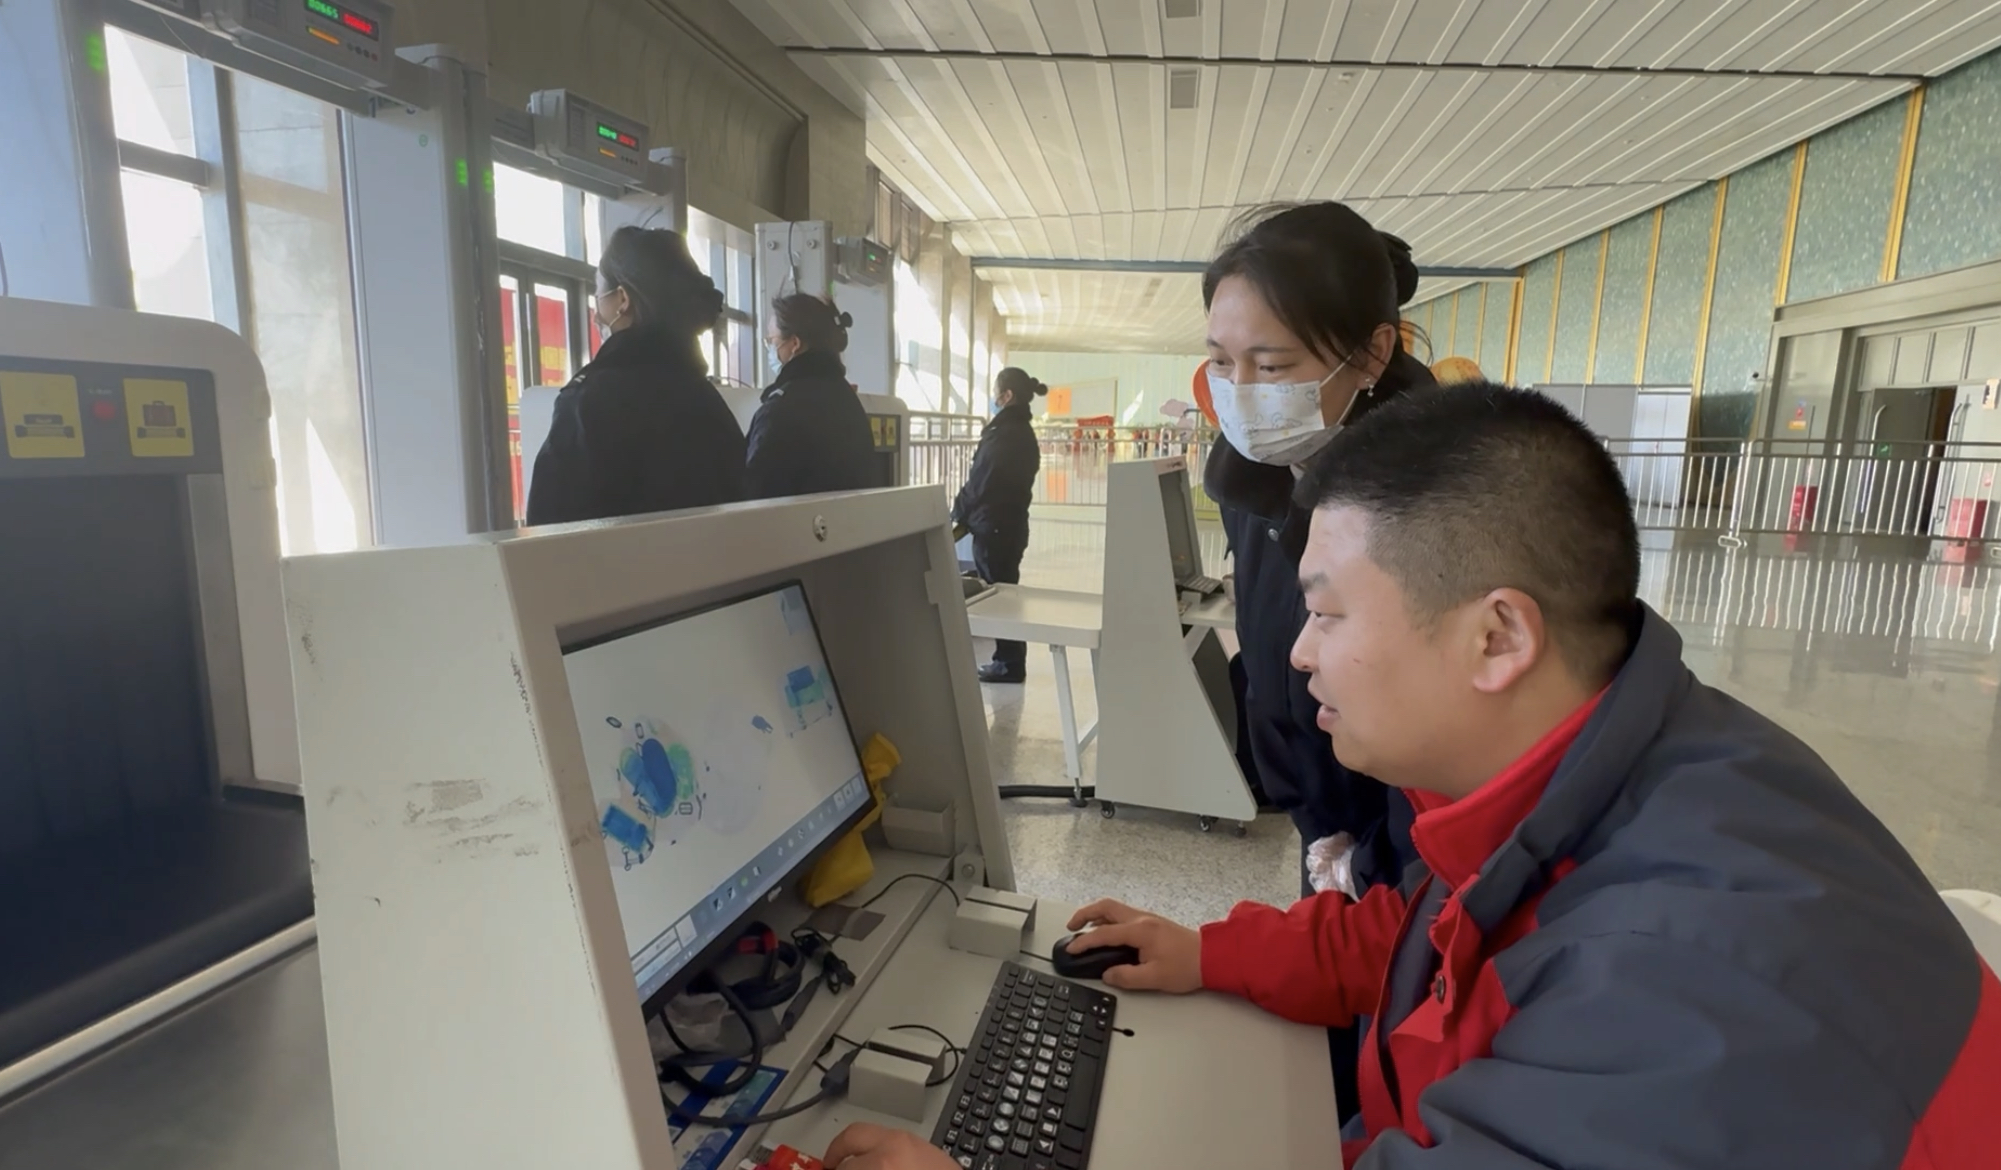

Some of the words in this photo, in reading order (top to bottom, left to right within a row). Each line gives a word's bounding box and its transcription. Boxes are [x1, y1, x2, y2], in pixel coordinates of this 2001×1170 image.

[947, 1130, 958, 1140] F1
[954, 1111, 965, 1123] F2
[960, 1095, 971, 1106] F3
[970, 1124, 980, 1133] 2
[975, 1107, 986, 1116] 3
